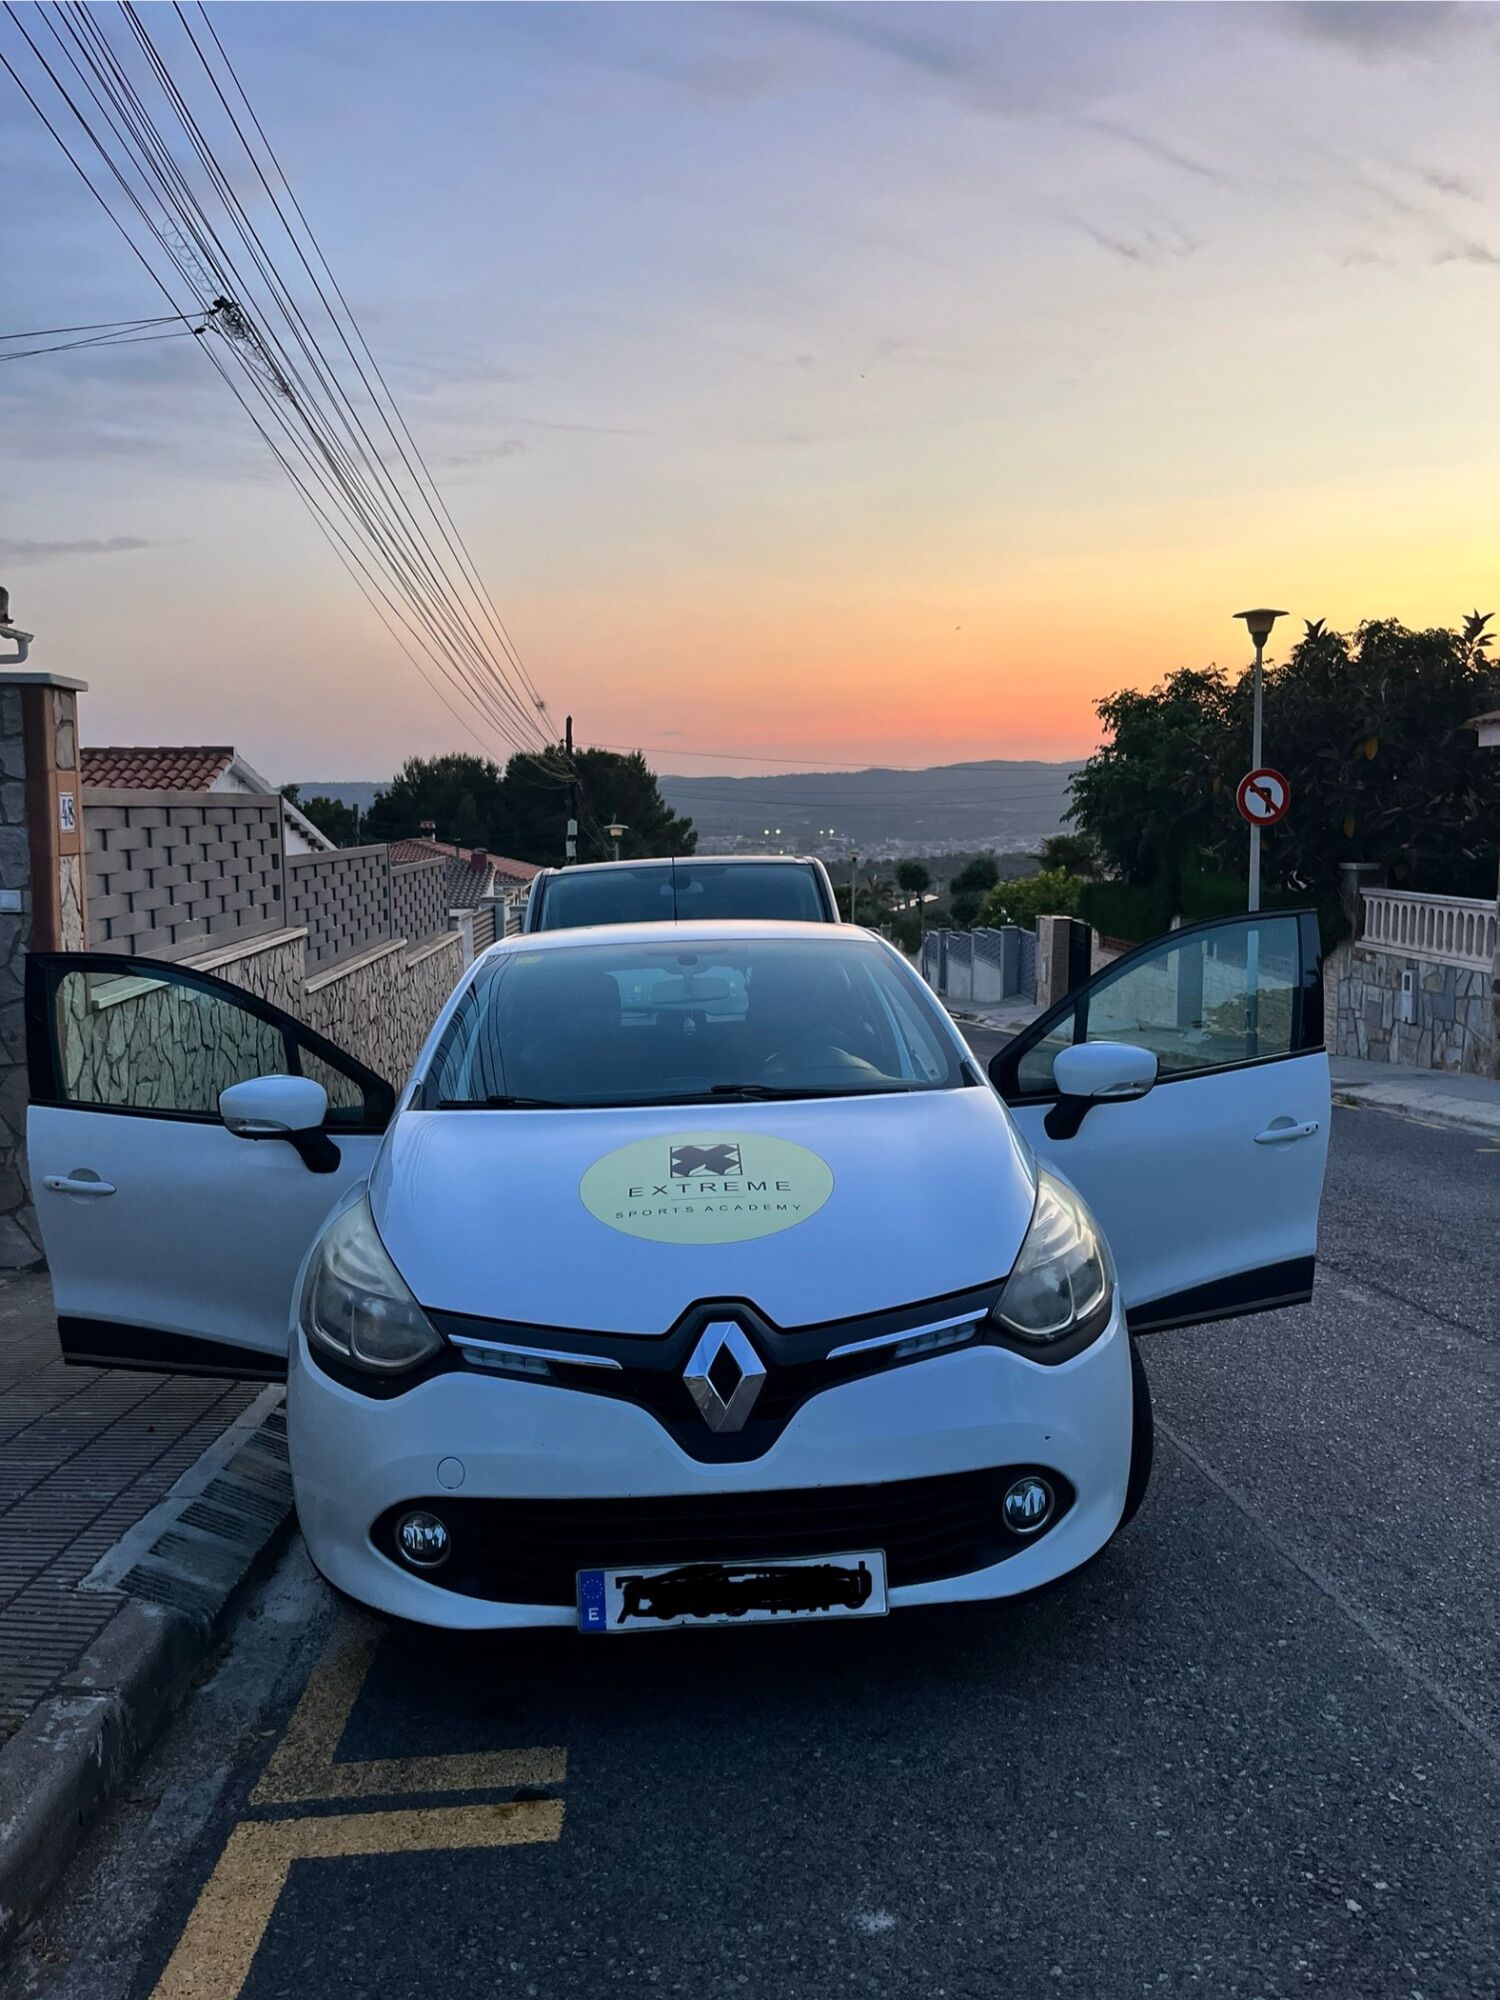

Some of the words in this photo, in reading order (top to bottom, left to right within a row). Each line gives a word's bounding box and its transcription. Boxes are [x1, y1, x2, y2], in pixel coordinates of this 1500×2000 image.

[62, 798, 75, 827] 48
[628, 1181, 793, 1198] EXTREME
[615, 1206, 695, 1219] SPORTS
[704, 1203, 802, 1213] ACADEMY
[588, 1607, 600, 1622] E
